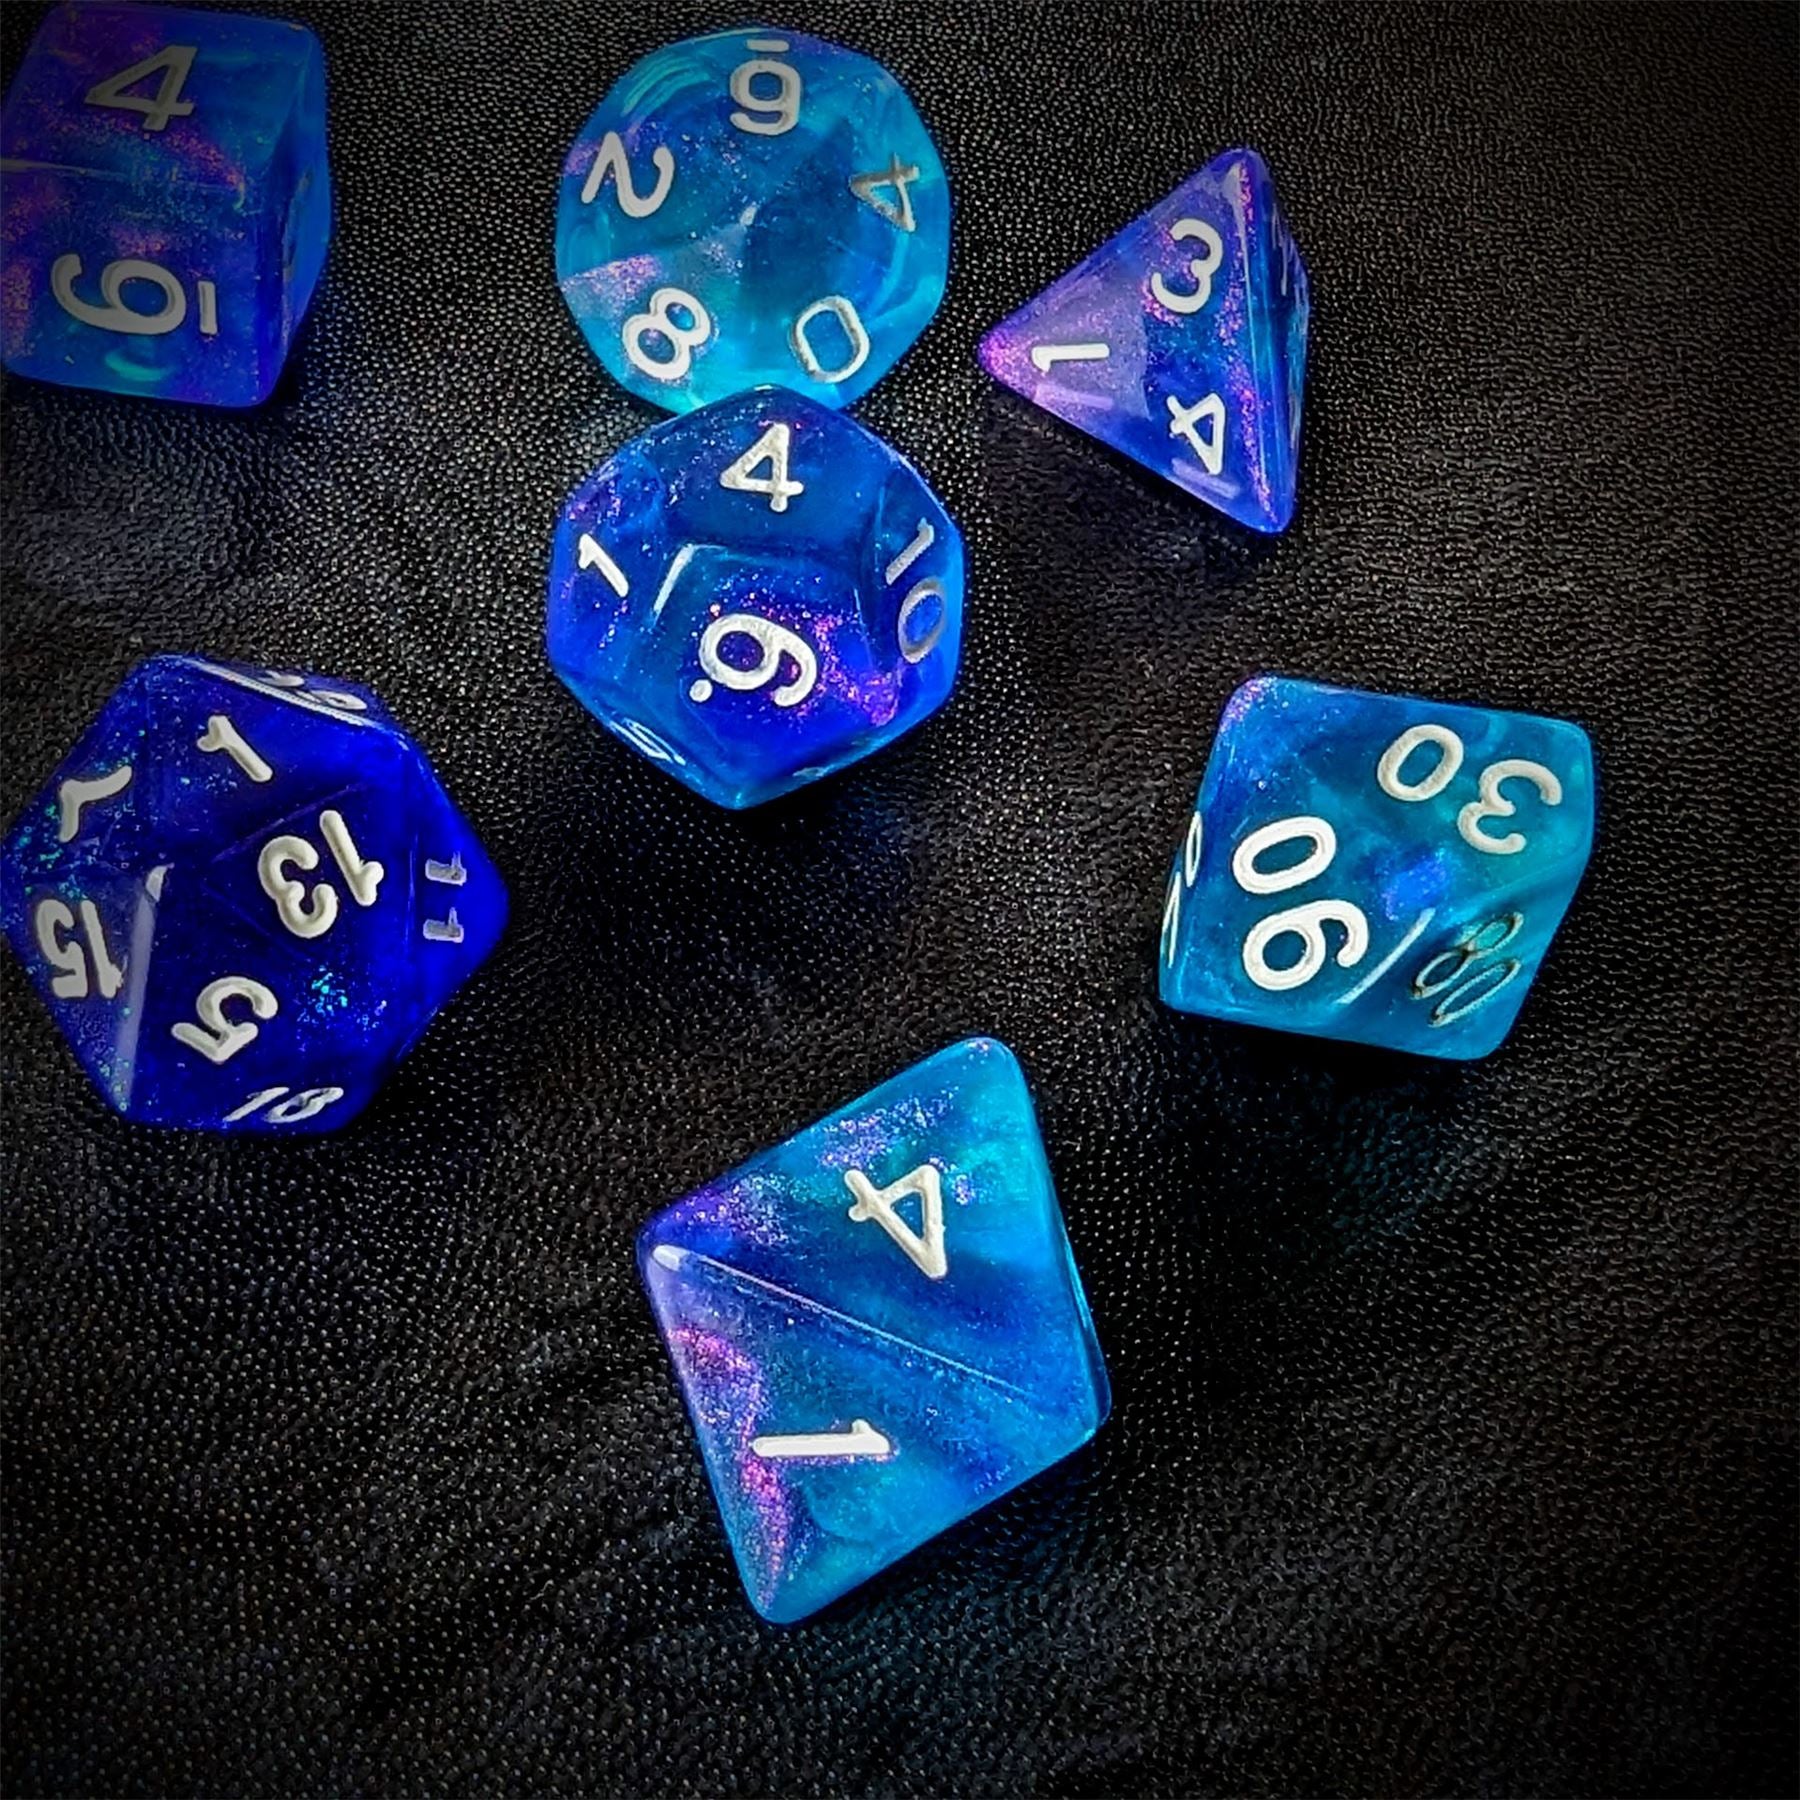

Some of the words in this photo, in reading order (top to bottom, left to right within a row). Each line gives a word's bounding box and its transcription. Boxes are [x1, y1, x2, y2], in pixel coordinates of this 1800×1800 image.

[85, 46, 197, 131] 4
[581, 131, 674, 218] 2
[849, 153, 919, 232] 4
[1151, 218, 1223, 313] 3
[622, 288, 711, 380] 8
[789, 295, 870, 383] 0
[1031, 343, 1110, 374] 1
[720, 423, 804, 512] 4
[1166, 393, 1226, 475] 4
[578, 533, 629, 597] 1
[885, 517, 946, 663] 10
[197, 715, 272, 782] 1
[1377, 724, 1562, 854] 30
[59, 766, 132, 842] 7
[258, 810, 384, 938] 13
[1232, 816, 1369, 991] 90
[36, 899, 124, 998] 15
[1411, 911, 1524, 1028] 80
[171, 977, 278, 1063] 5
[844, 1164, 947, 1279] 4
[752, 1419, 890, 1457] 1
